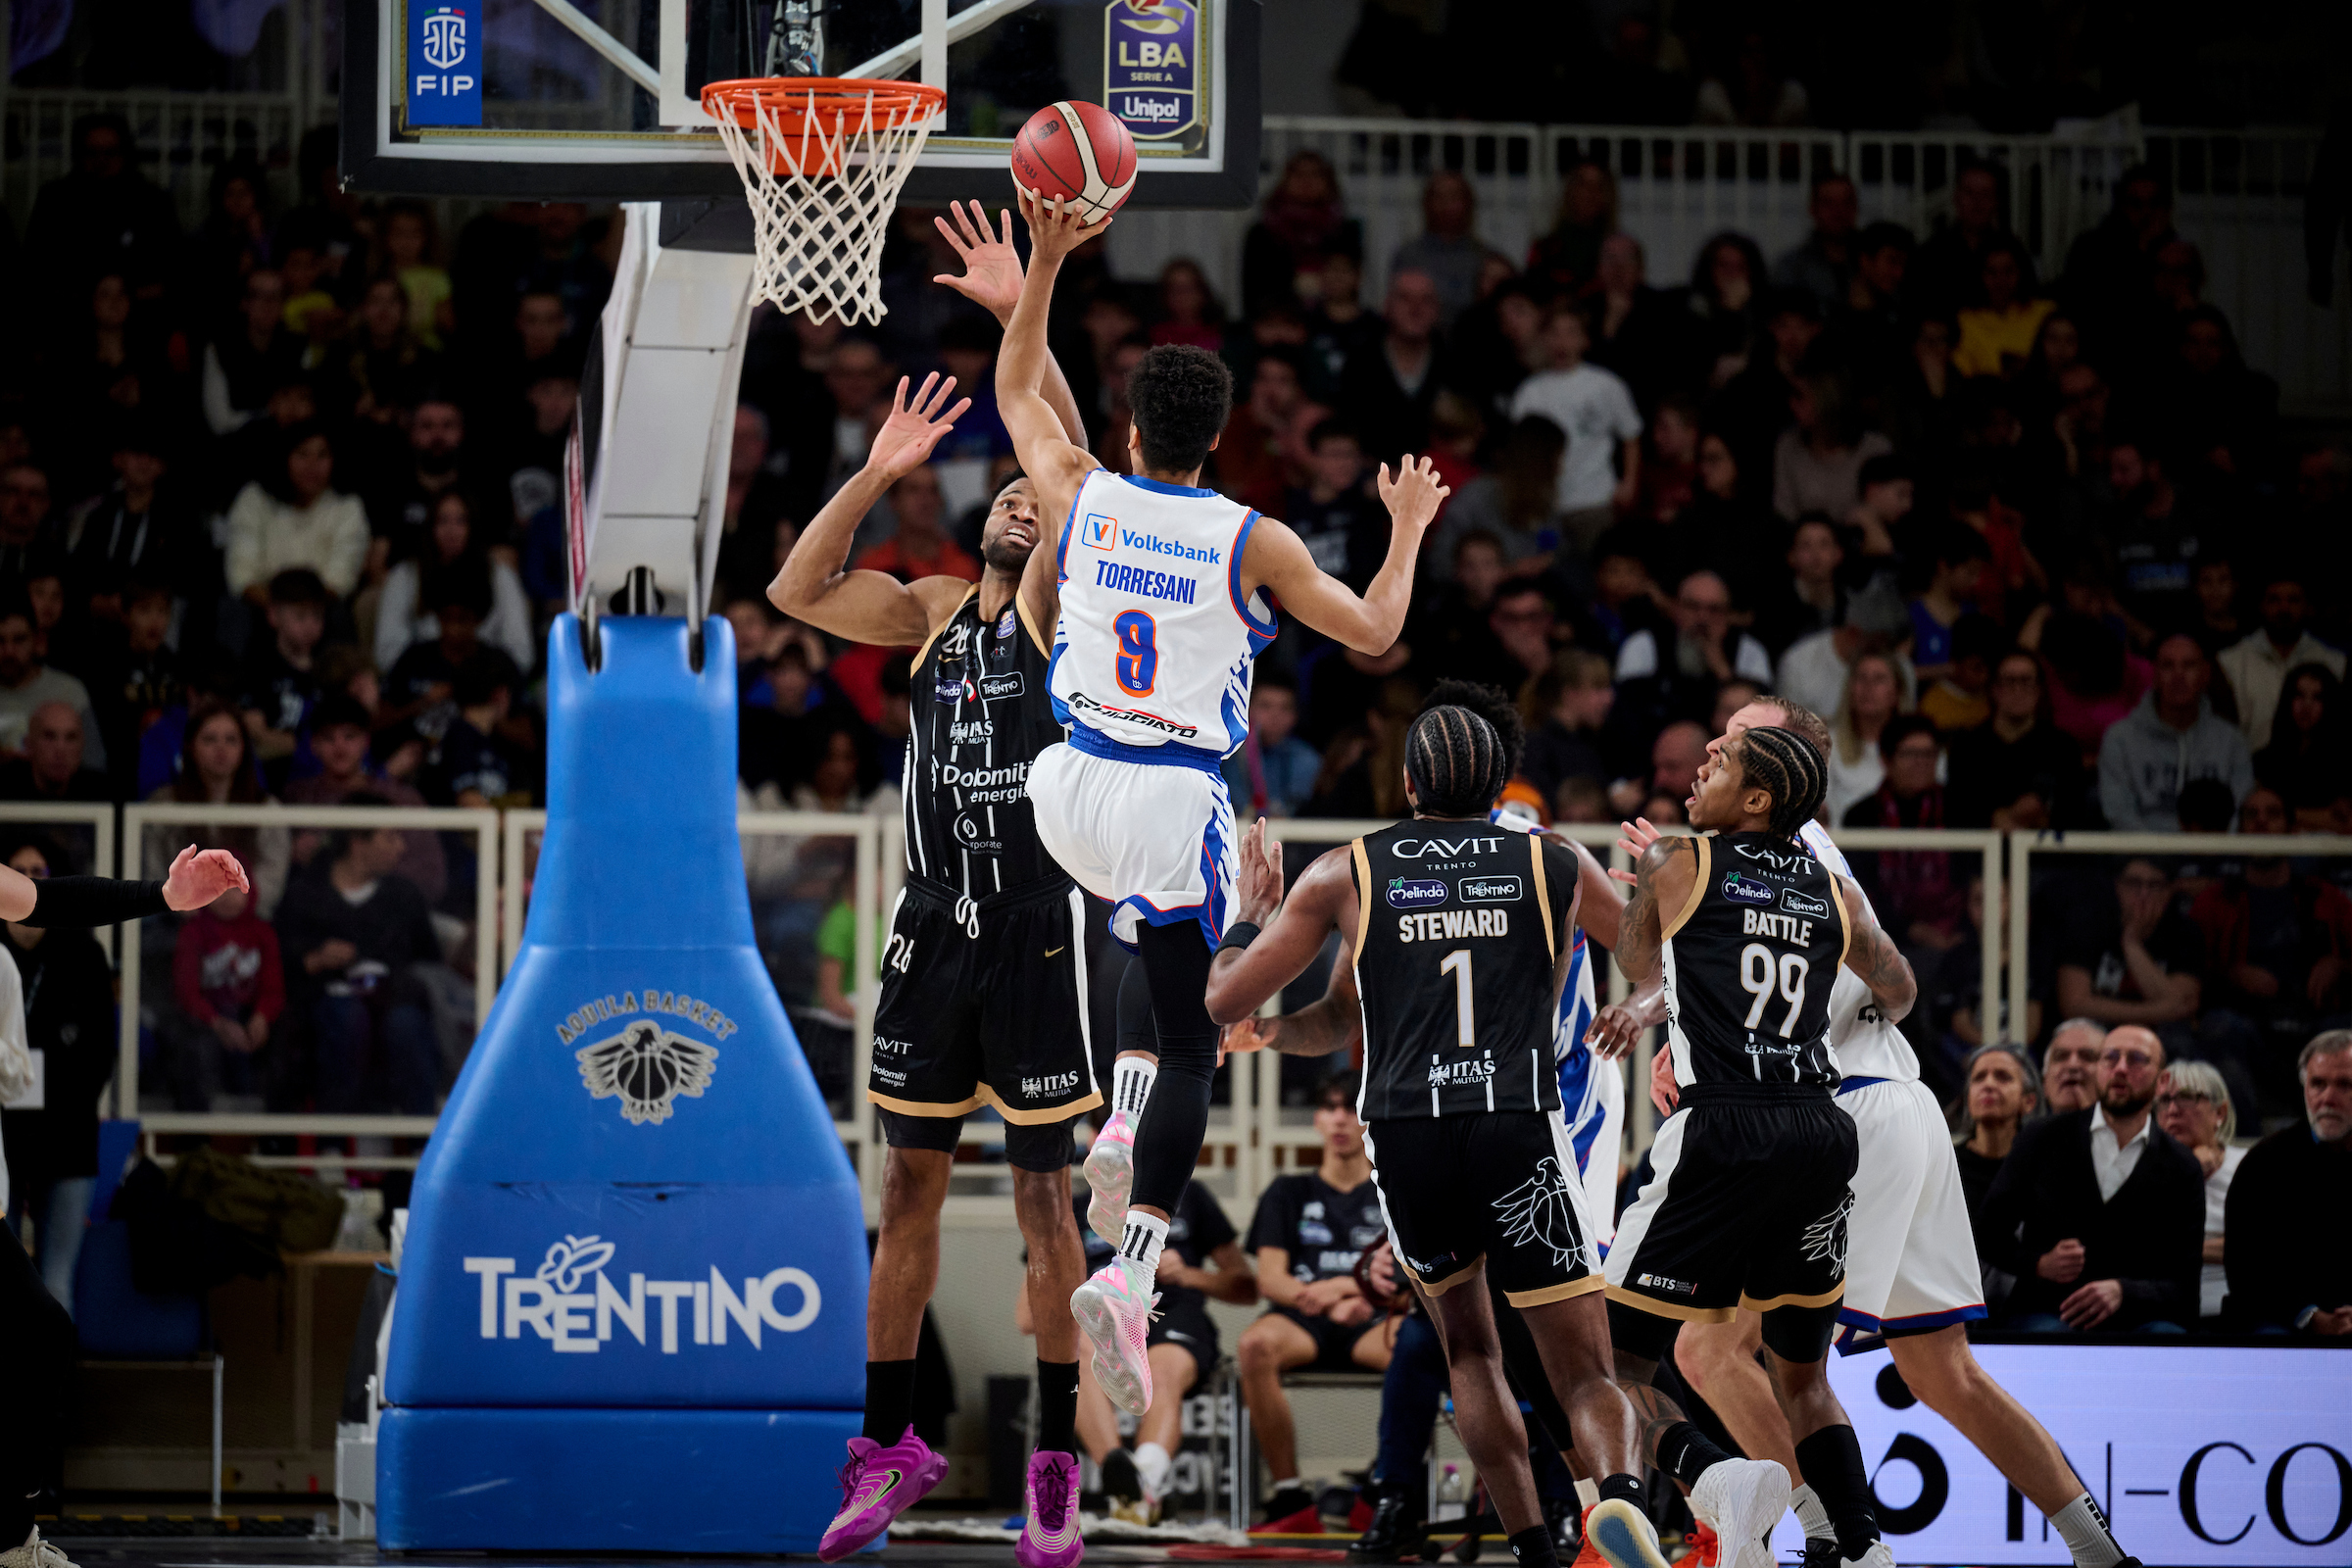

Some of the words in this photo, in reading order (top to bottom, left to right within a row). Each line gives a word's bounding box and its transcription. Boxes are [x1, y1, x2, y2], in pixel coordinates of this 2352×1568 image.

[1118, 41, 1187, 68] LBA
[416, 75, 474, 96] FIP
[1130, 72, 1162, 81] SERIE
[1164, 73, 1174, 82] A
[1124, 96, 1180, 122] Unipol
[1122, 528, 1221, 564] Volksbank
[1096, 560, 1197, 605] TORRESANI
[1113, 609, 1158, 698] 9
[1392, 837, 1505, 858] CAVIT
[1426, 861, 1477, 871] TRENTO
[1734, 844, 1815, 875] CAVIT
[1757, 868, 1795, 882] TRENTO
[1390, 885, 1445, 901] Melinda
[1465, 883, 1515, 897] TRENTINO
[1725, 882, 1772, 899] Melinda
[1398, 908, 1508, 944] STEWARD
[1743, 908, 1812, 949] BATTLE
[892, 933, 915, 974] 26
[1441, 949, 1475, 1048] 1
[1740, 943, 1809, 1039] 99
[557, 991, 639, 1046] AQUILA
[644, 990, 739, 1041] BASKET
[873, 1034, 912, 1054] AVIT
[873, 1063, 906, 1081] Dolomiti
[1452, 1059, 1495, 1077] ITAS
[880, 1077, 905, 1087] energia
[1044, 1070, 1079, 1091] ITAS
[1452, 1076, 1486, 1085] MUTUA
[1045, 1088, 1071, 1098] MUTUA
[1653, 1276, 1676, 1290] BTS
[464, 1256, 821, 1353] TRENTINO
